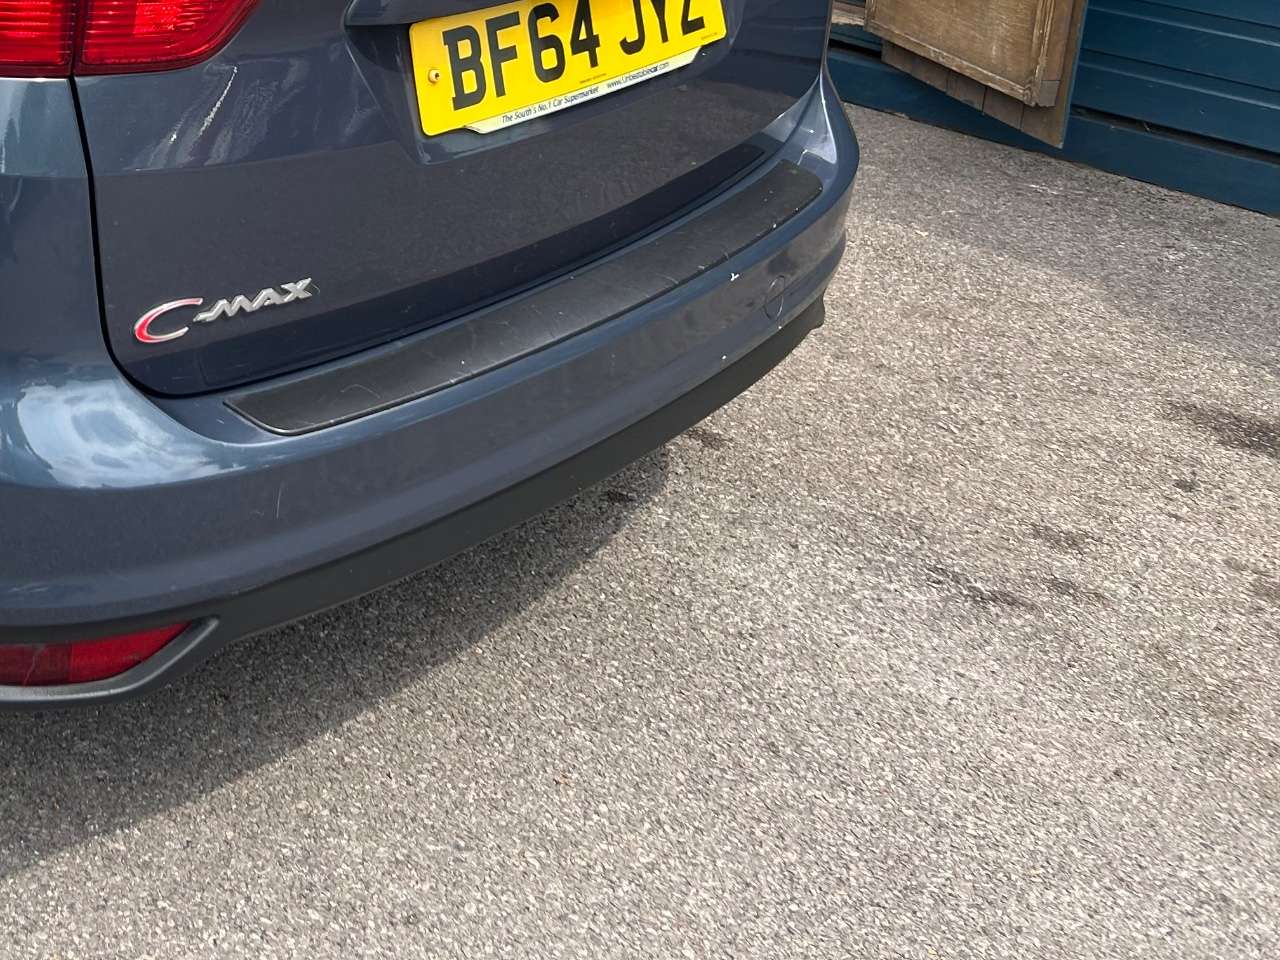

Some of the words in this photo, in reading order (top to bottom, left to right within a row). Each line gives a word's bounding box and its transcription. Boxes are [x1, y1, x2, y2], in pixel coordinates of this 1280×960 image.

[502, 114, 513, 124] The
[514, 105, 537, 120] South's
[553, 98, 563, 108] Car
[564, 86, 600, 105] Supermarket
